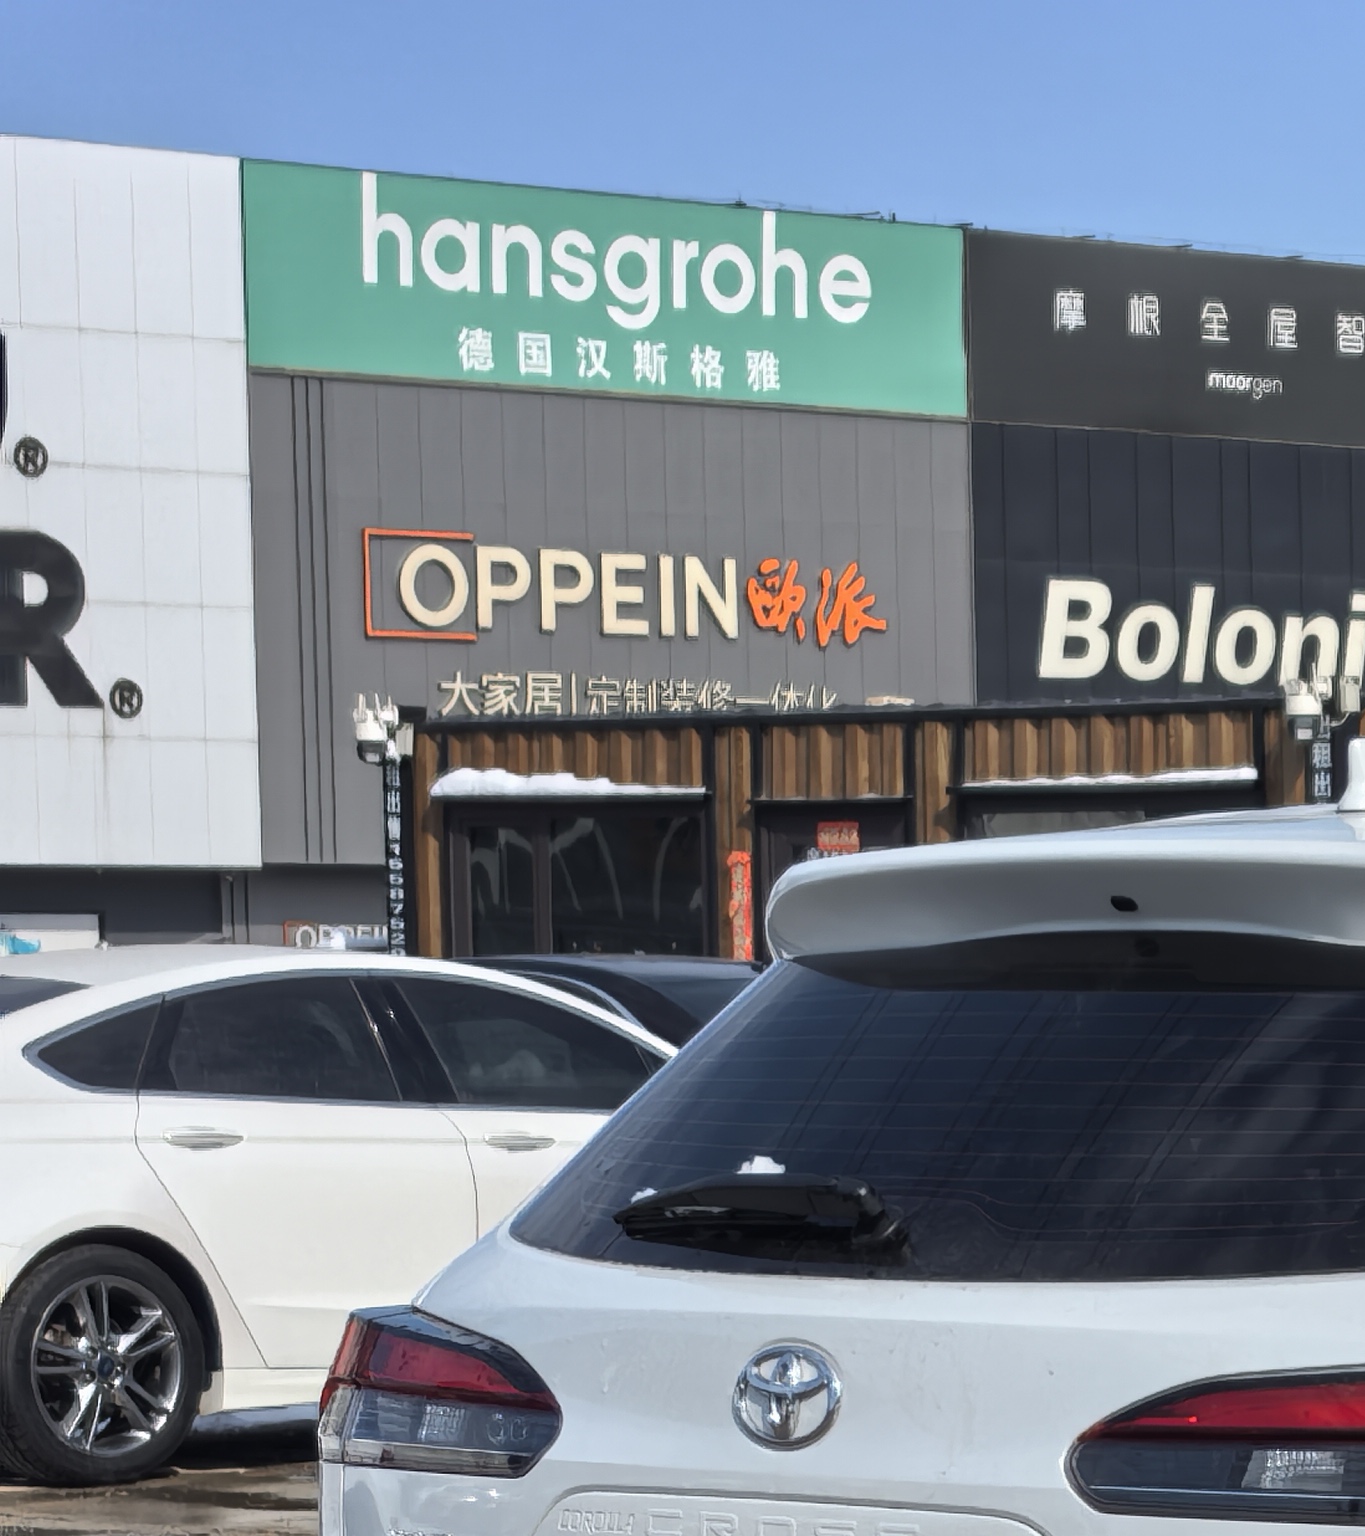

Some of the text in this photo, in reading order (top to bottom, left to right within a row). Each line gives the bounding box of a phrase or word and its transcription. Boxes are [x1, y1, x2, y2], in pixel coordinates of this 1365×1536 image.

[362, 172, 871, 328] hansgrohe
[457, 327, 781, 392] 德国汉斯格雅
[400, 543, 888, 648] OPPEIN 欧派
[557, 1508, 636, 1536] COROLLA
